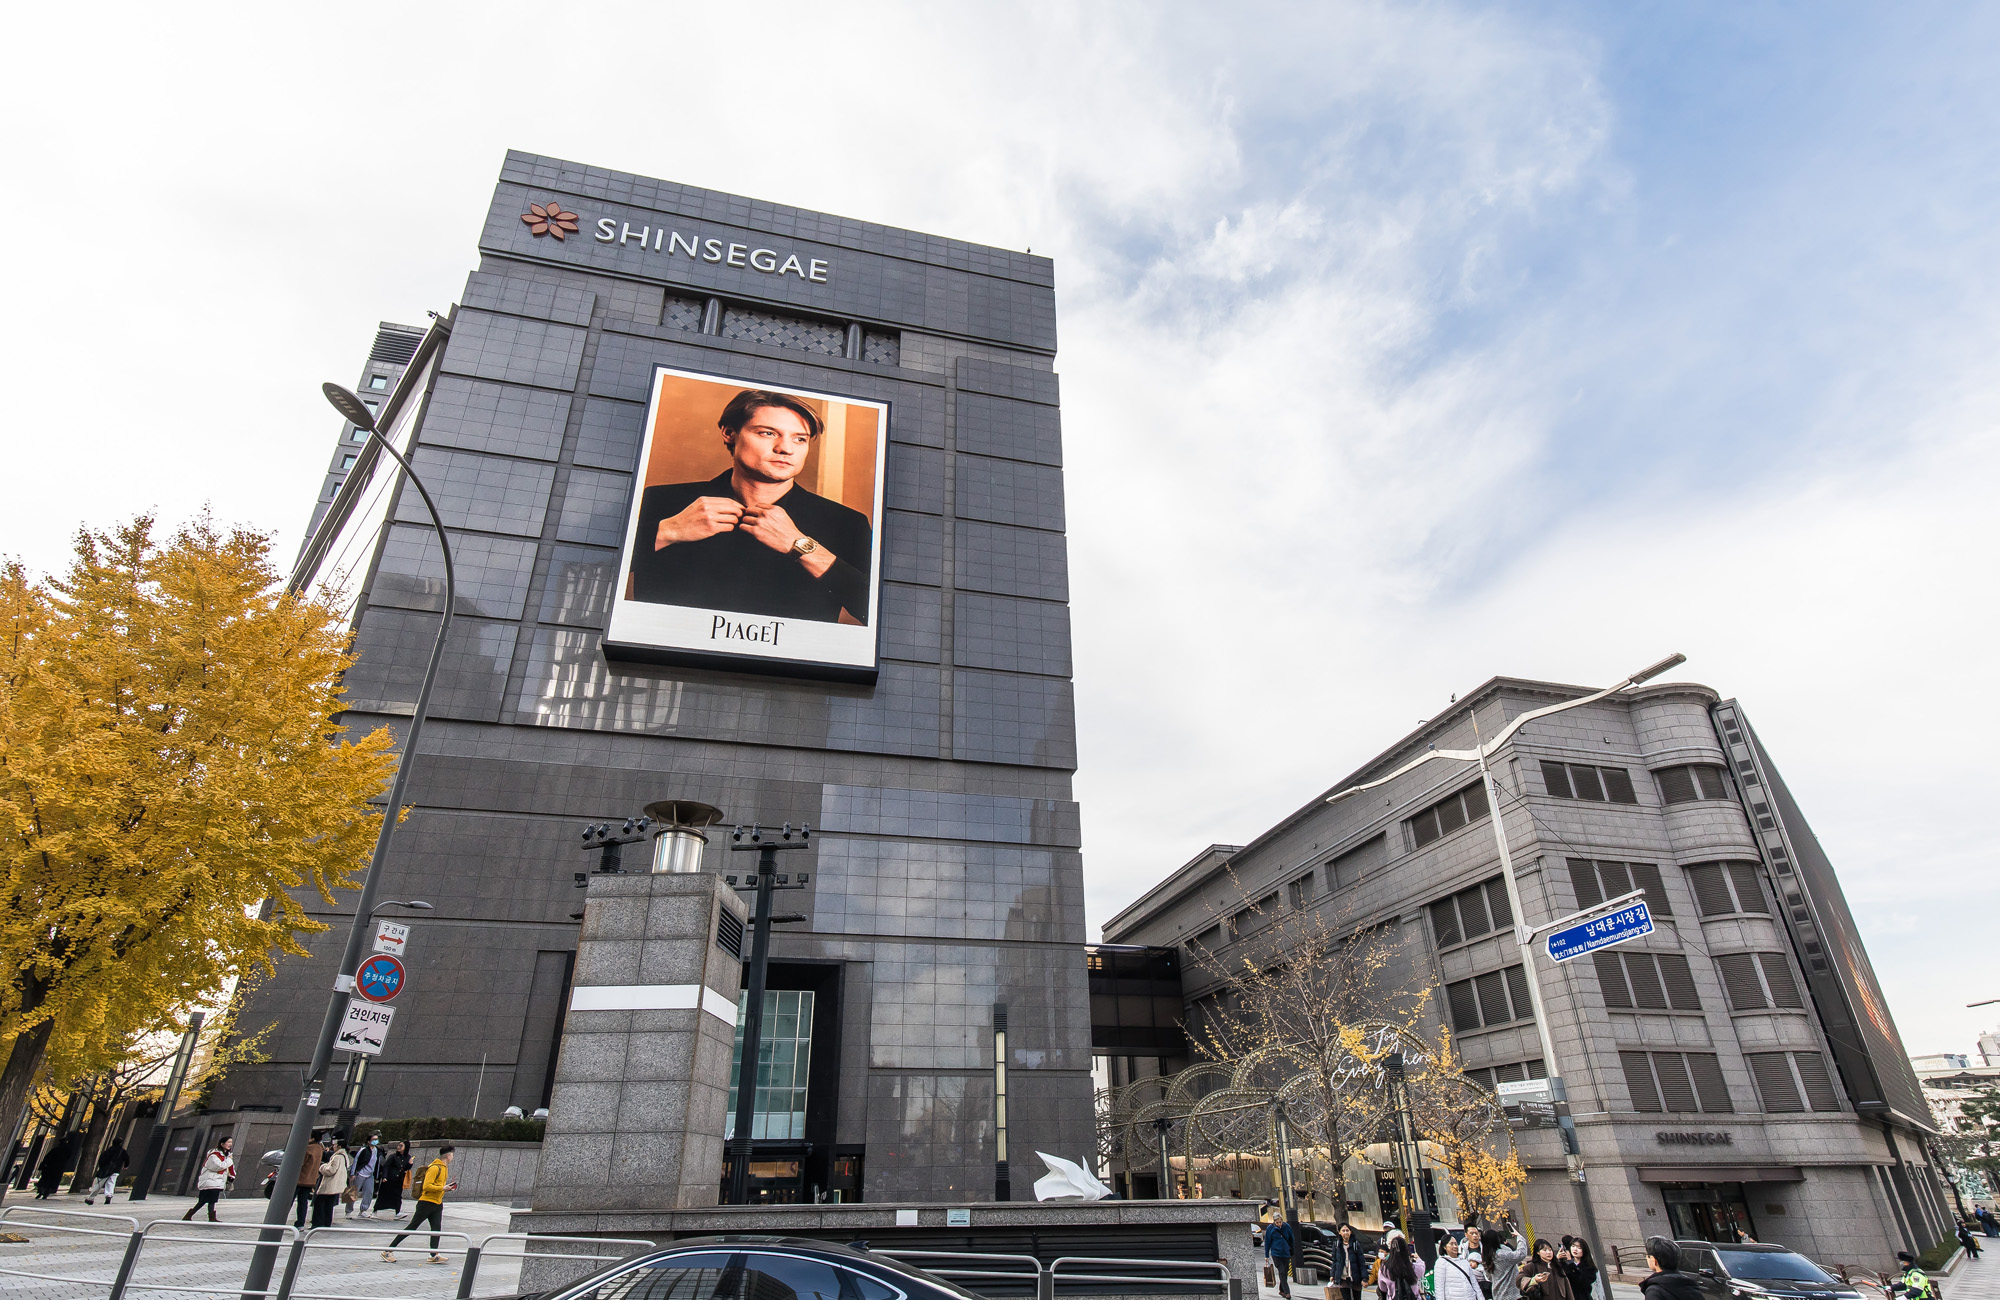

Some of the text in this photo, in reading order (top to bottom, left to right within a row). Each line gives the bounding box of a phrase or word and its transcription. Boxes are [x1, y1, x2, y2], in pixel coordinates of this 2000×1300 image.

[595, 218, 828, 283] SHINSEGAE
[710, 615, 785, 646] PIAGET
[1586, 906, 1646, 937] 남대문시장길
[383, 924, 405, 936] 구간내
[364, 971, 399, 985] 주정차금지
[350, 1007, 391, 1025] 견인지역
[1655, 1132, 1734, 1146] SHINSEGAE
[1381, 1171, 1396, 1179] LOUI
